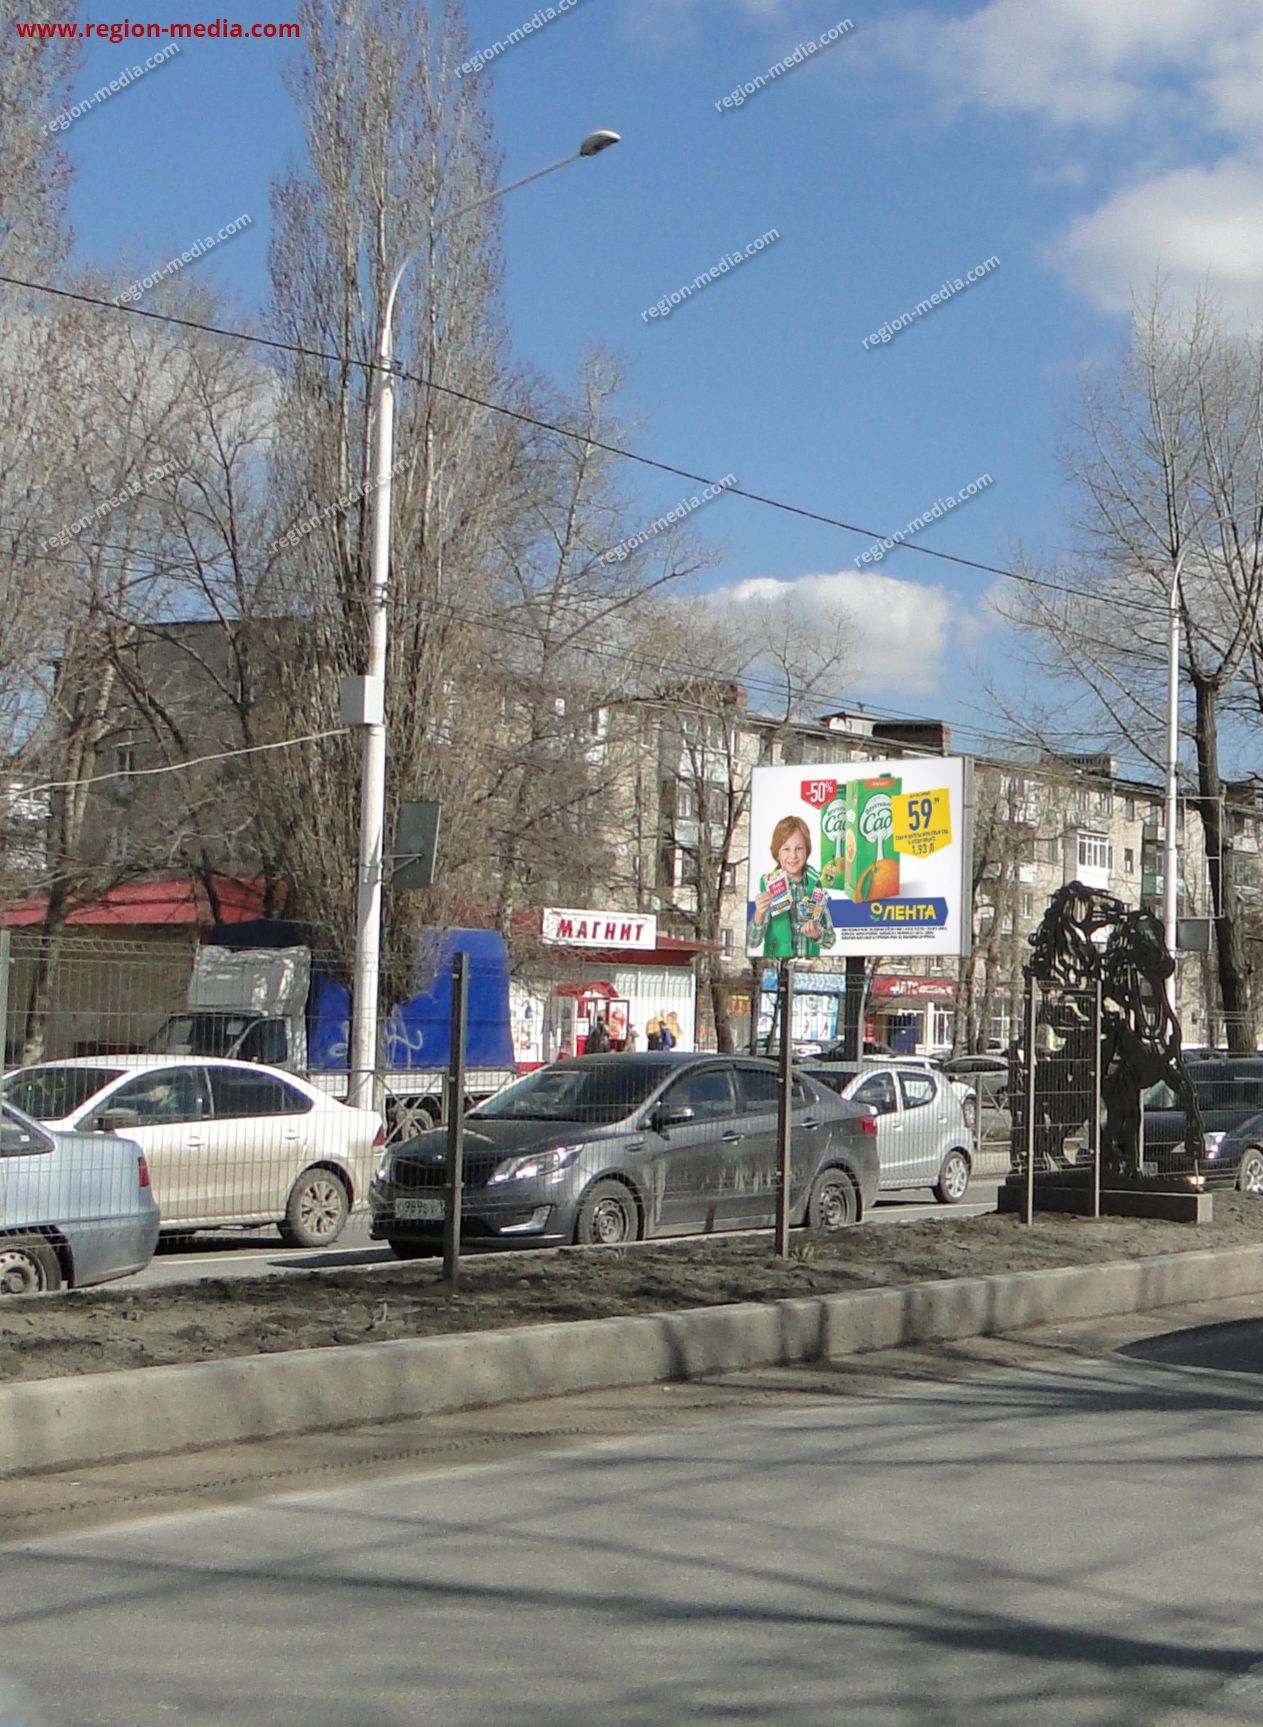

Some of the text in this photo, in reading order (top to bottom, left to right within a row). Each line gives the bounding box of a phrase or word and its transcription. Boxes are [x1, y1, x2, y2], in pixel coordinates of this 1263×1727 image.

[805, 782, 833, 802] -50%
[908, 798, 932, 831] 59
[883, 904, 937, 921] ЛЕНТА
[556, 918, 644, 942] МАГНИТ
